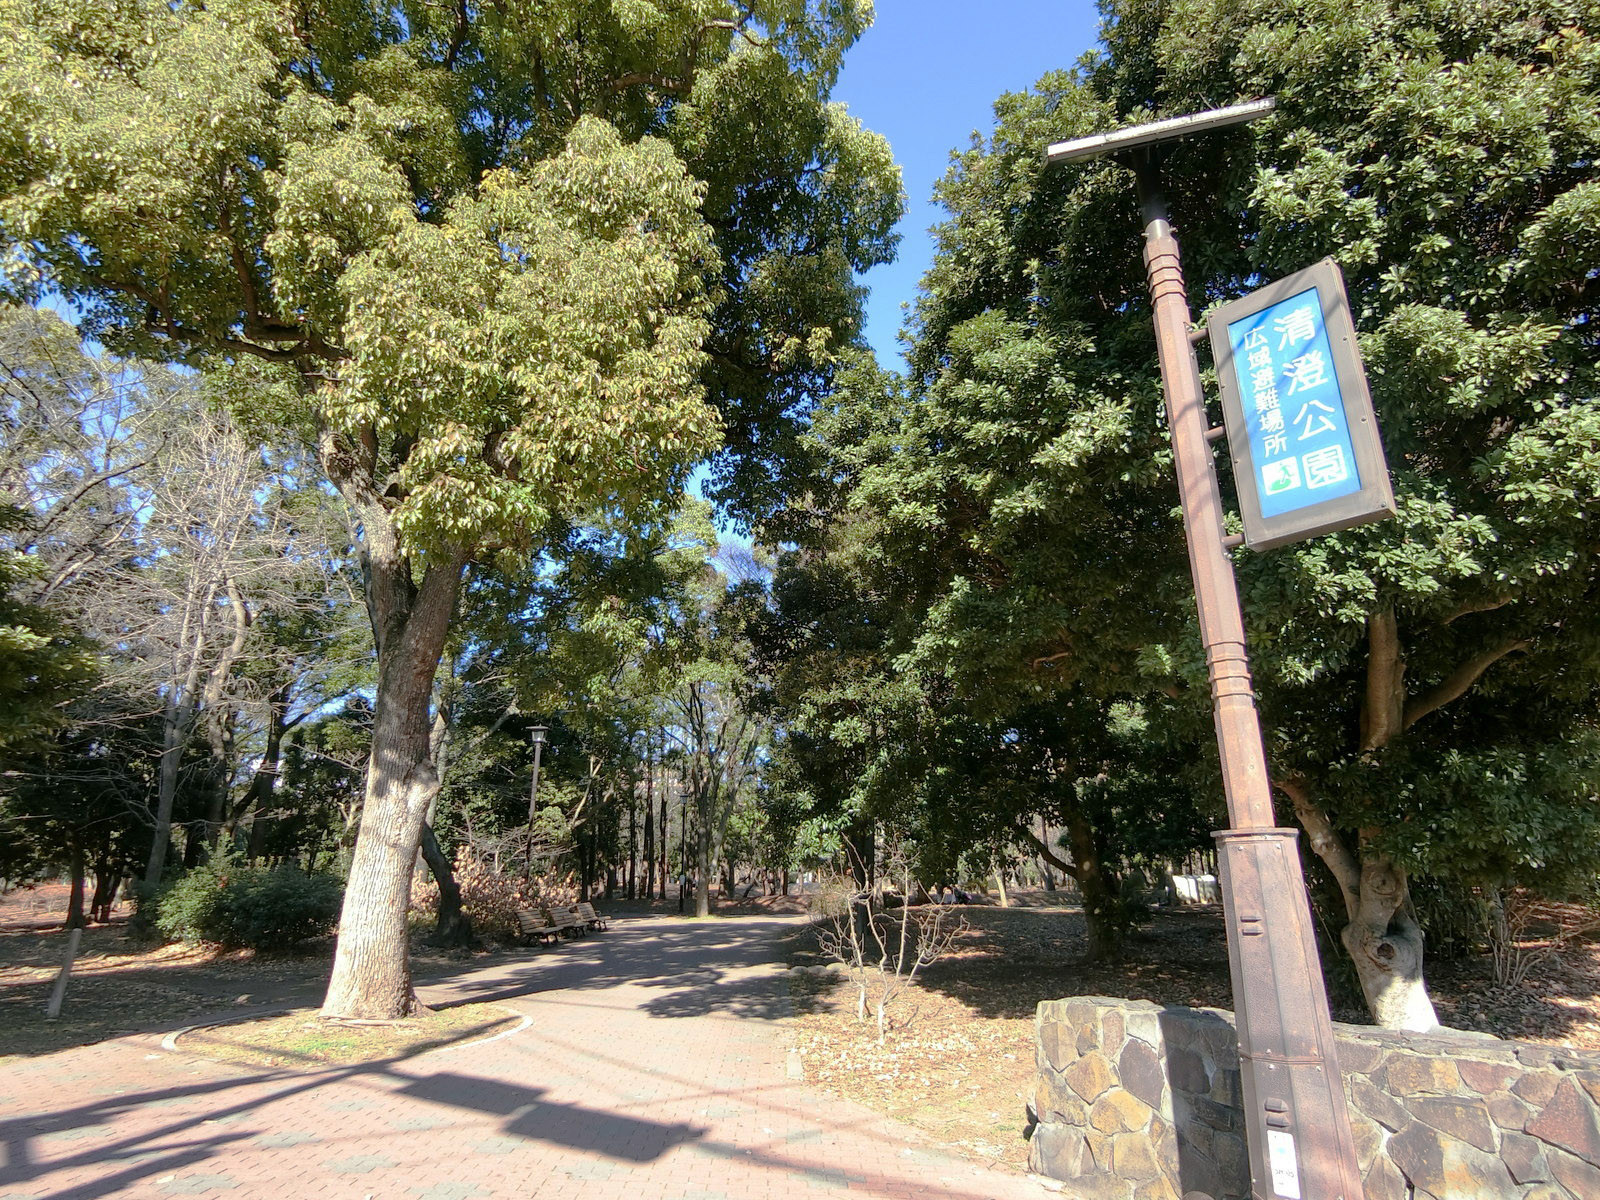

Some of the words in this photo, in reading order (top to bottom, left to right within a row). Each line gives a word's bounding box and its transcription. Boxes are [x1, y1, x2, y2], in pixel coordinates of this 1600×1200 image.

[1244, 326, 1287, 458] 広域避難場所
[1273, 306, 1347, 489] 清澄公園
